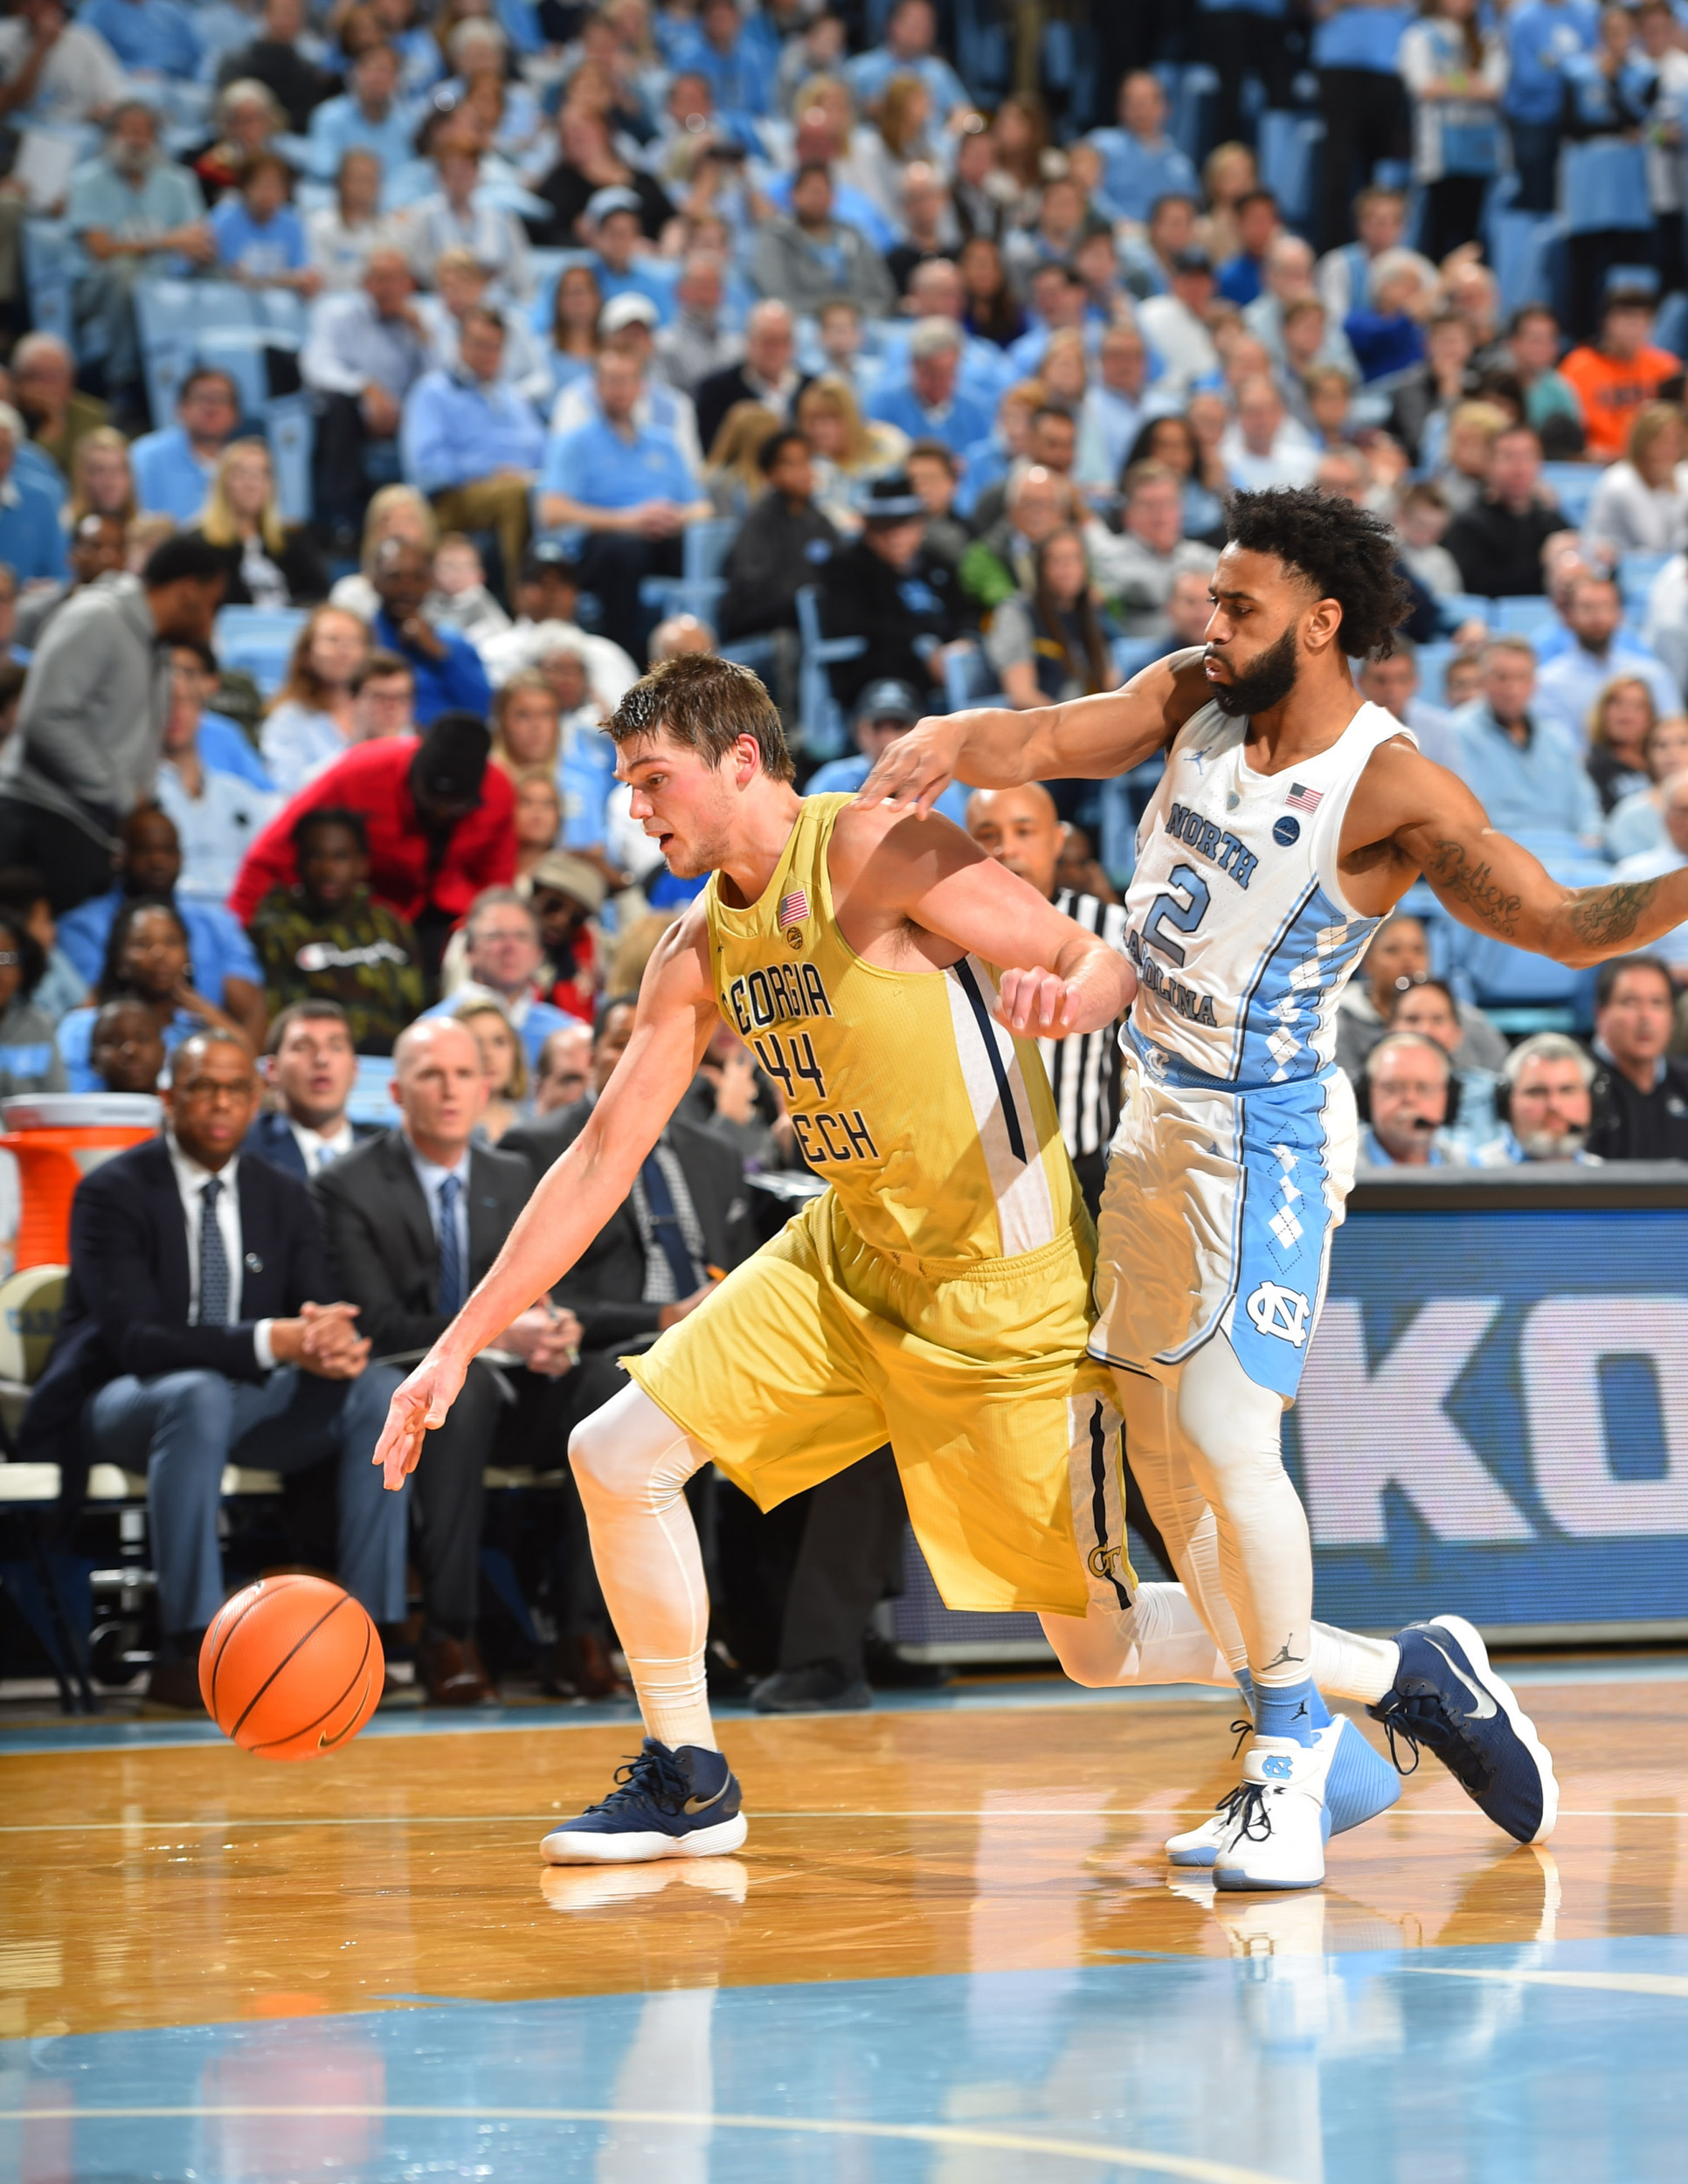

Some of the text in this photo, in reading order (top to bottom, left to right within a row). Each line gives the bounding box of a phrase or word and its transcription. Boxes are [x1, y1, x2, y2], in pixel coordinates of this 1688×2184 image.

[1165, 803, 1259, 890] NORTH
[1141, 863, 1211, 968] 2
[723, 962, 834, 1036] EORGIA
[1124, 930, 1217, 1027] AOLINA
[753, 1031, 827, 1102] 44
[791, 1109, 881, 1163] ECH
